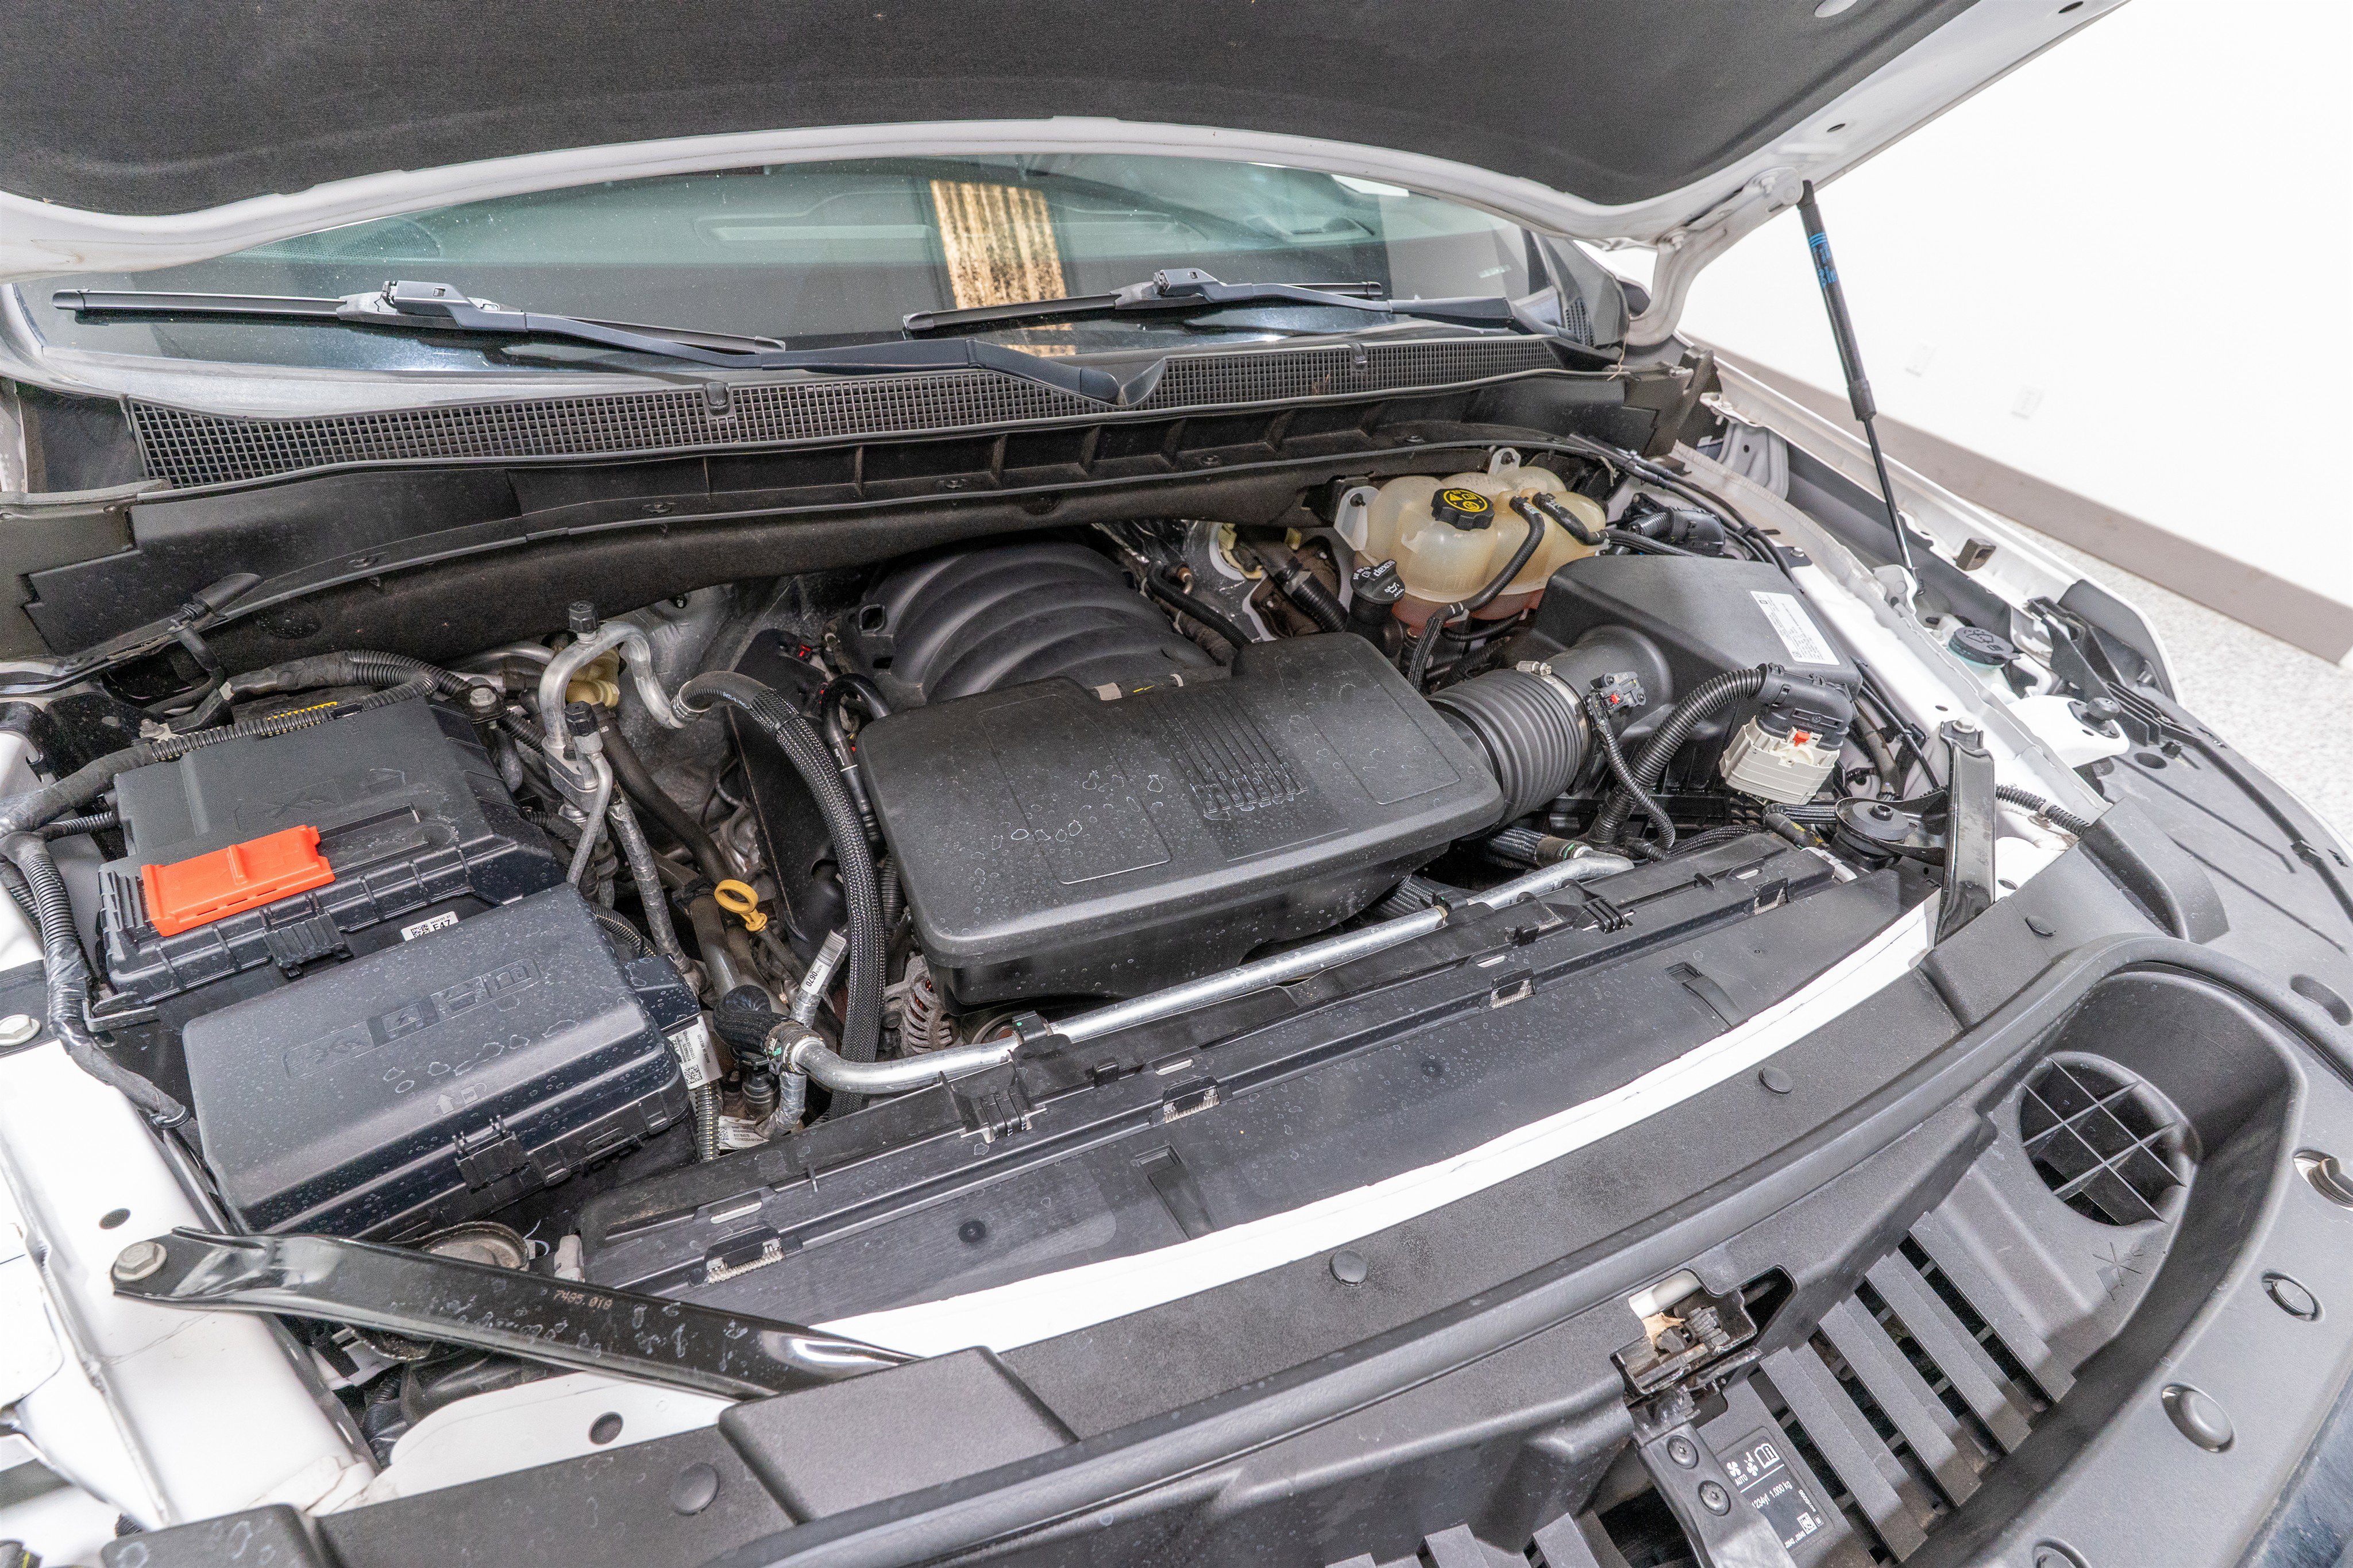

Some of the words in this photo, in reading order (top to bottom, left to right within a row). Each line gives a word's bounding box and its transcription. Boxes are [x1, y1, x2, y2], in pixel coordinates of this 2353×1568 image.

[1373, 559, 1395, 577] dexos
[805, 971, 817, 987] 0670
[1735, 1474, 1748, 1486] AUTO
[1769, 1484, 1785, 1498] 1.000
[1785, 1481, 1793, 1492] kg
